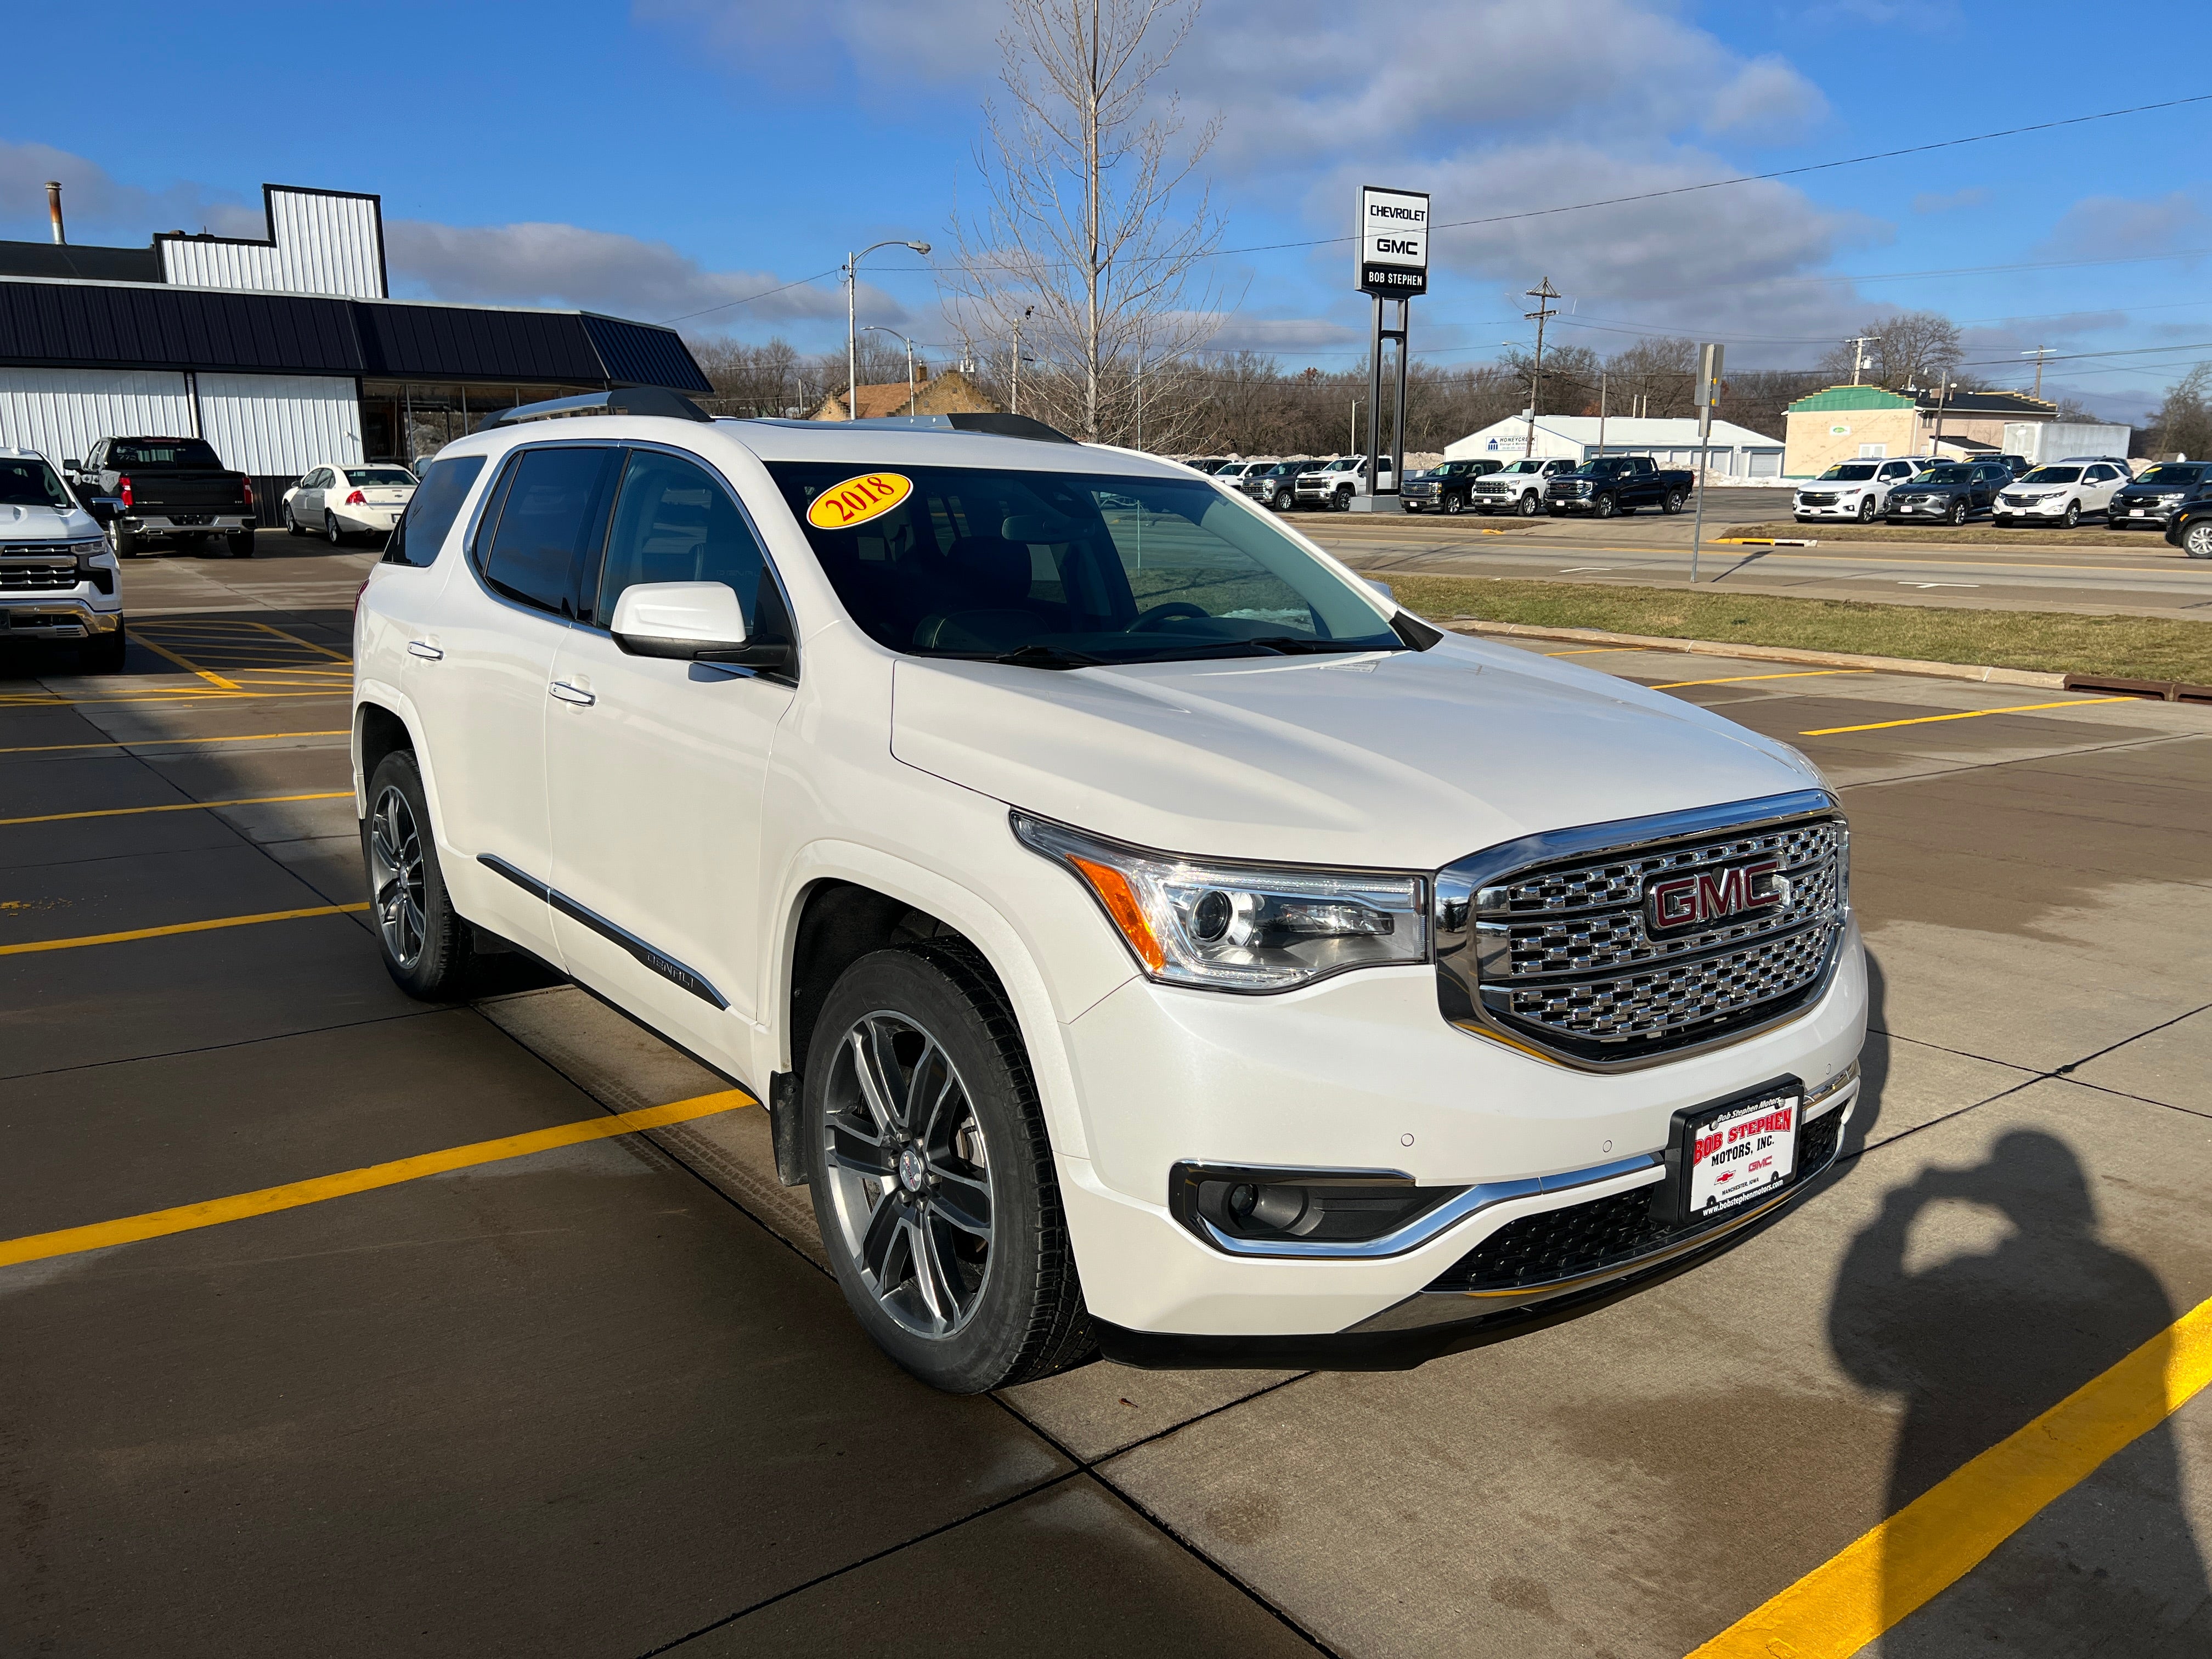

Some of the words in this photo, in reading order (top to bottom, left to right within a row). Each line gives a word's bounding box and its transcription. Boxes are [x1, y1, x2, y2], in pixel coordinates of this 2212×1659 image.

[1370, 205, 1426, 221] CHEVROLET
[1377, 238, 1418, 255] GMC
[1369, 271, 1385, 283] BOB
[1388, 273, 1422, 286] STEPHEN
[825, 476, 895, 522] 2018
[1652, 859, 1782, 929] GMC
[646, 952, 695, 988] DENALI
[1717, 1111, 1731, 1122] Bob
[1731, 1104, 1759, 1118] Stephen
[1693, 1132, 1723, 1168] BOB
[1728, 1107, 1792, 1144] STEPHEN
[1711, 1141, 1753, 1167] MOTORS,
[1757, 1135, 1775, 1152] INC.
[1748, 1155, 1773, 1173] GMC
[1702, 1179, 1784, 1216] www.bobstephenmotors.com
